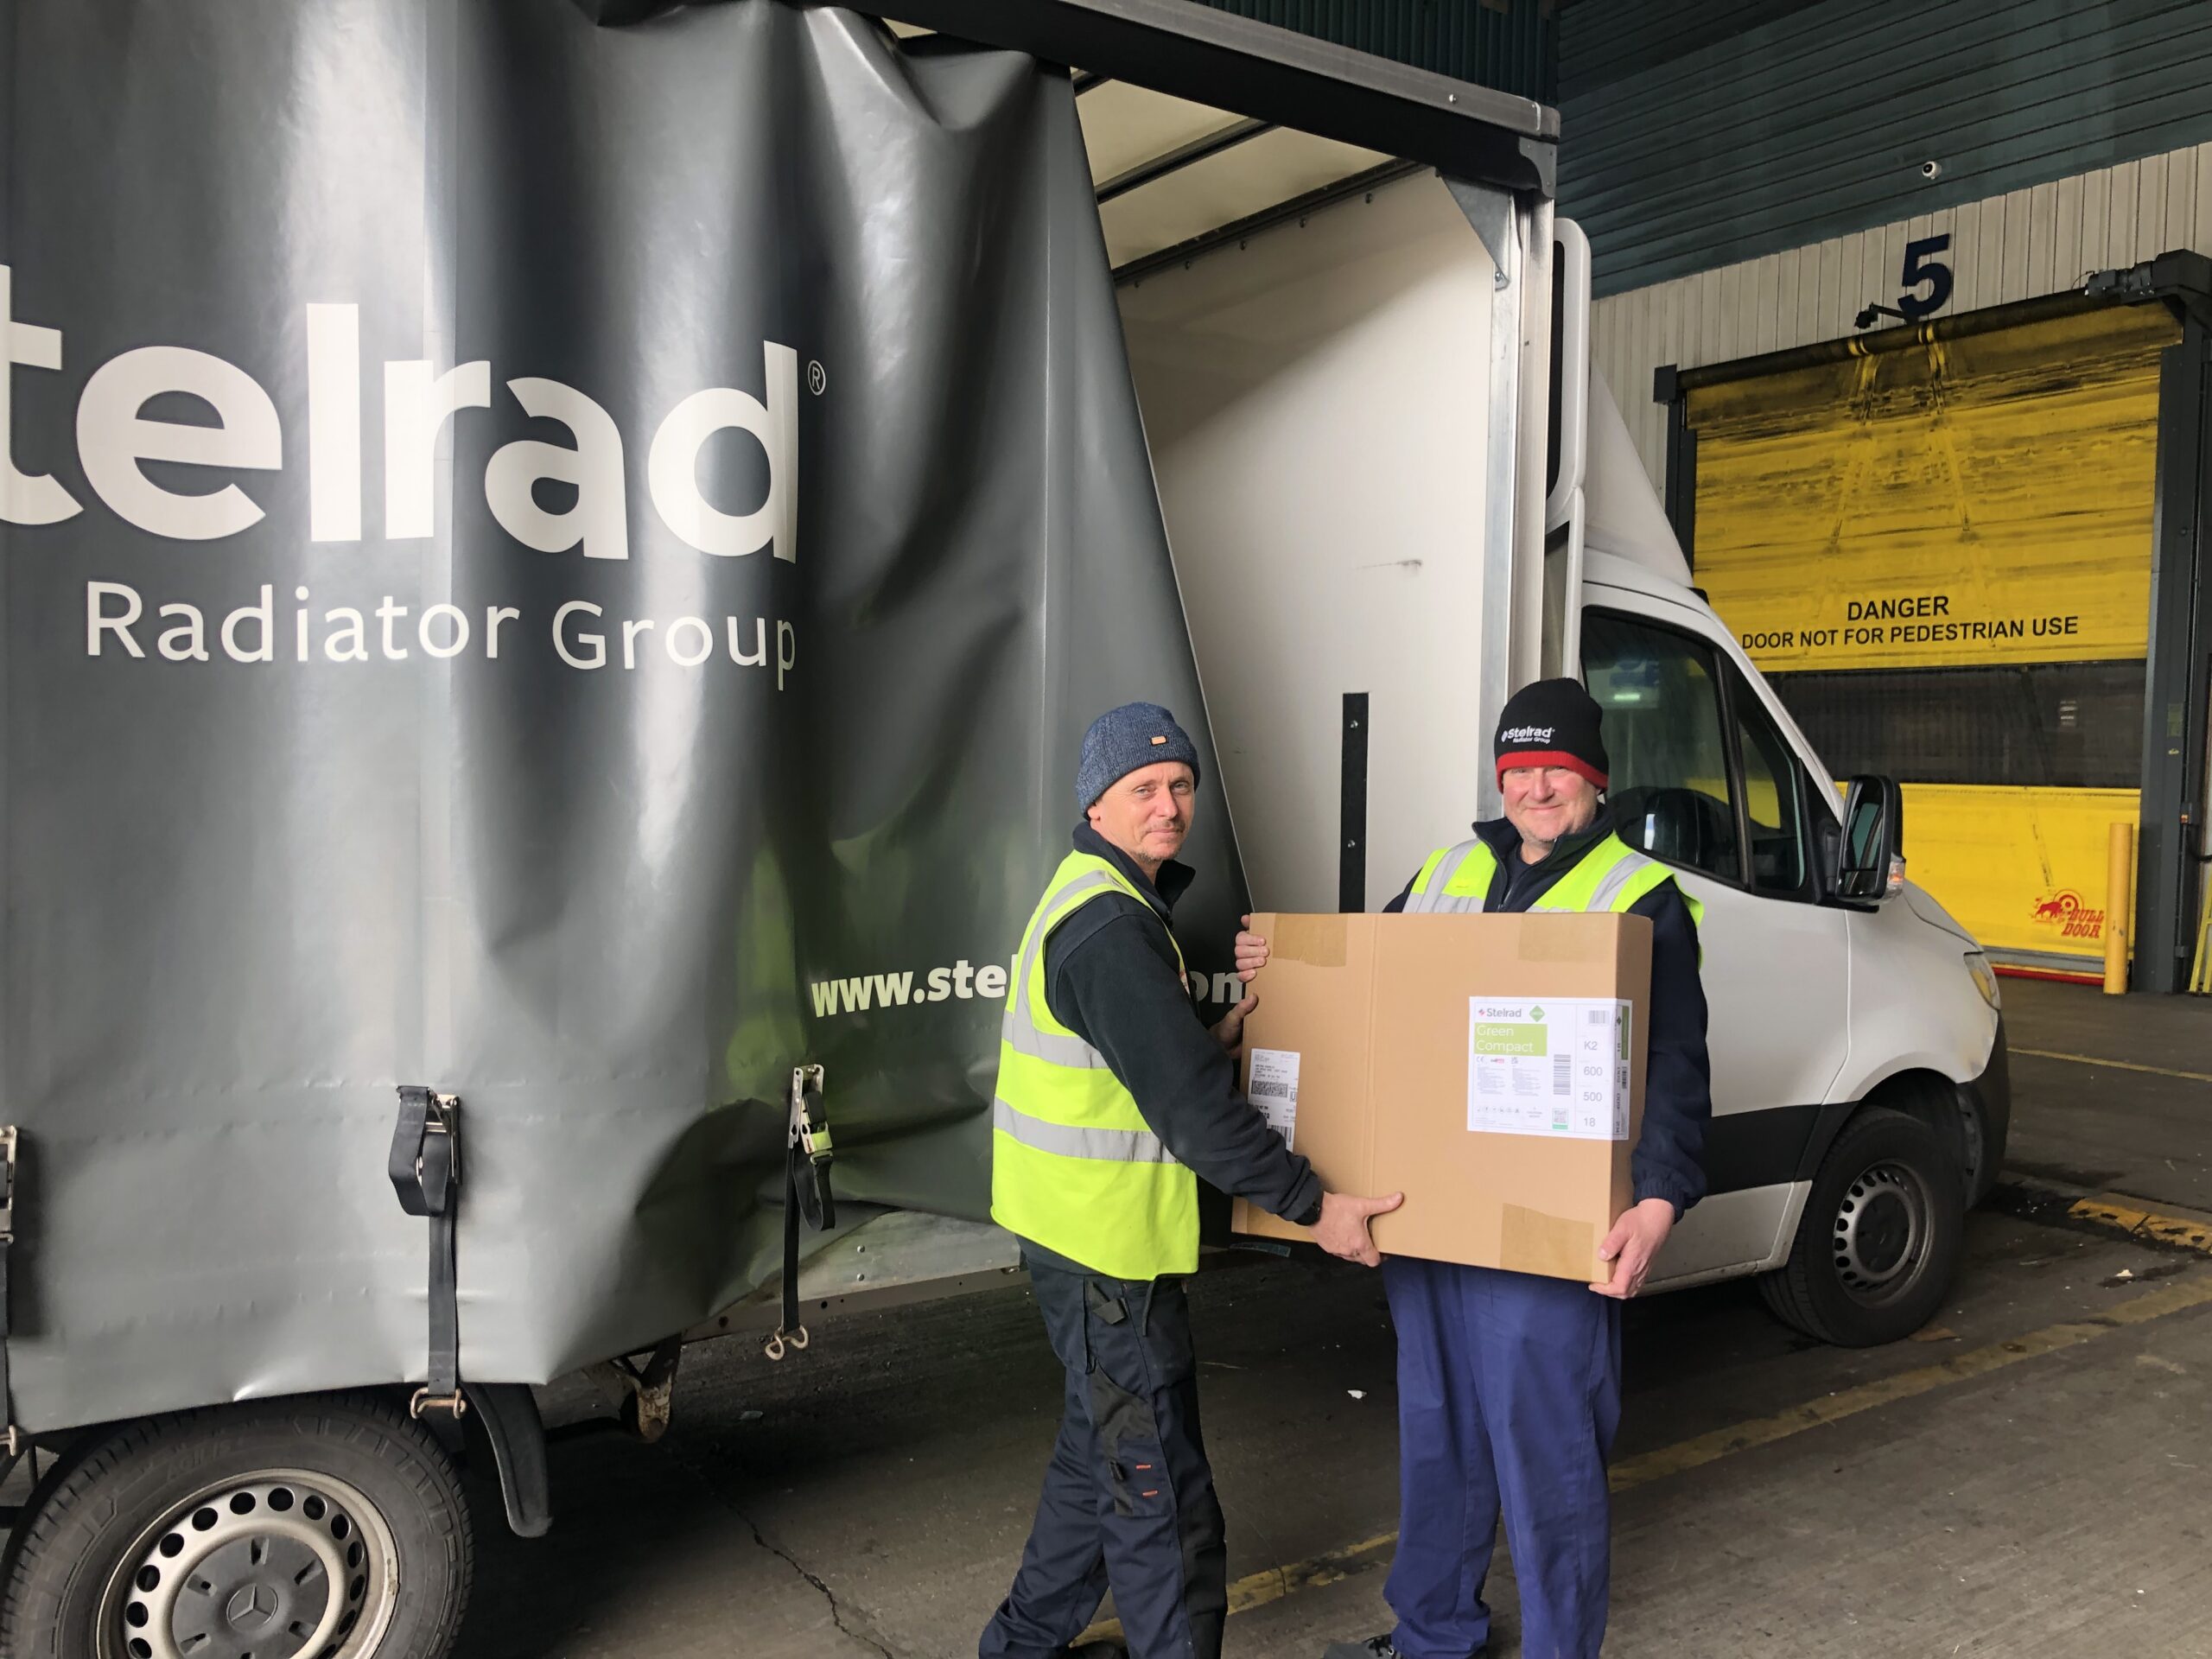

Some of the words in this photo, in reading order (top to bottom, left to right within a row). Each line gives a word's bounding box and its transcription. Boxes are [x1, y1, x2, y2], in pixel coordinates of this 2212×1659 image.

[1897, 232, 1952, 318] 5
[1847, 595, 1949, 622] DANGER
[86, 580, 519, 663] Radiator
[551, 600, 797, 691] Group
[1742, 632, 1794, 650] DOOR
[1800, 629, 1839, 647] NOT
[1844, 626, 1884, 645] FOR
[1890, 620, 2024, 643] PEDESTRIAN
[2032, 615, 2079, 637] USE
[2061, 923, 2101, 938] DOOR
[1486, 1007, 1522, 1017] Stelrad
[1477, 1025, 1514, 1036] Green
[1476, 1039, 1535, 1052] Compact
[1584, 1040, 1598, 1051] K2
[1583, 1066, 1603, 1077] 600
[1583, 1092, 1603, 1102] 500
[1583, 1117, 1596, 1127] 18
